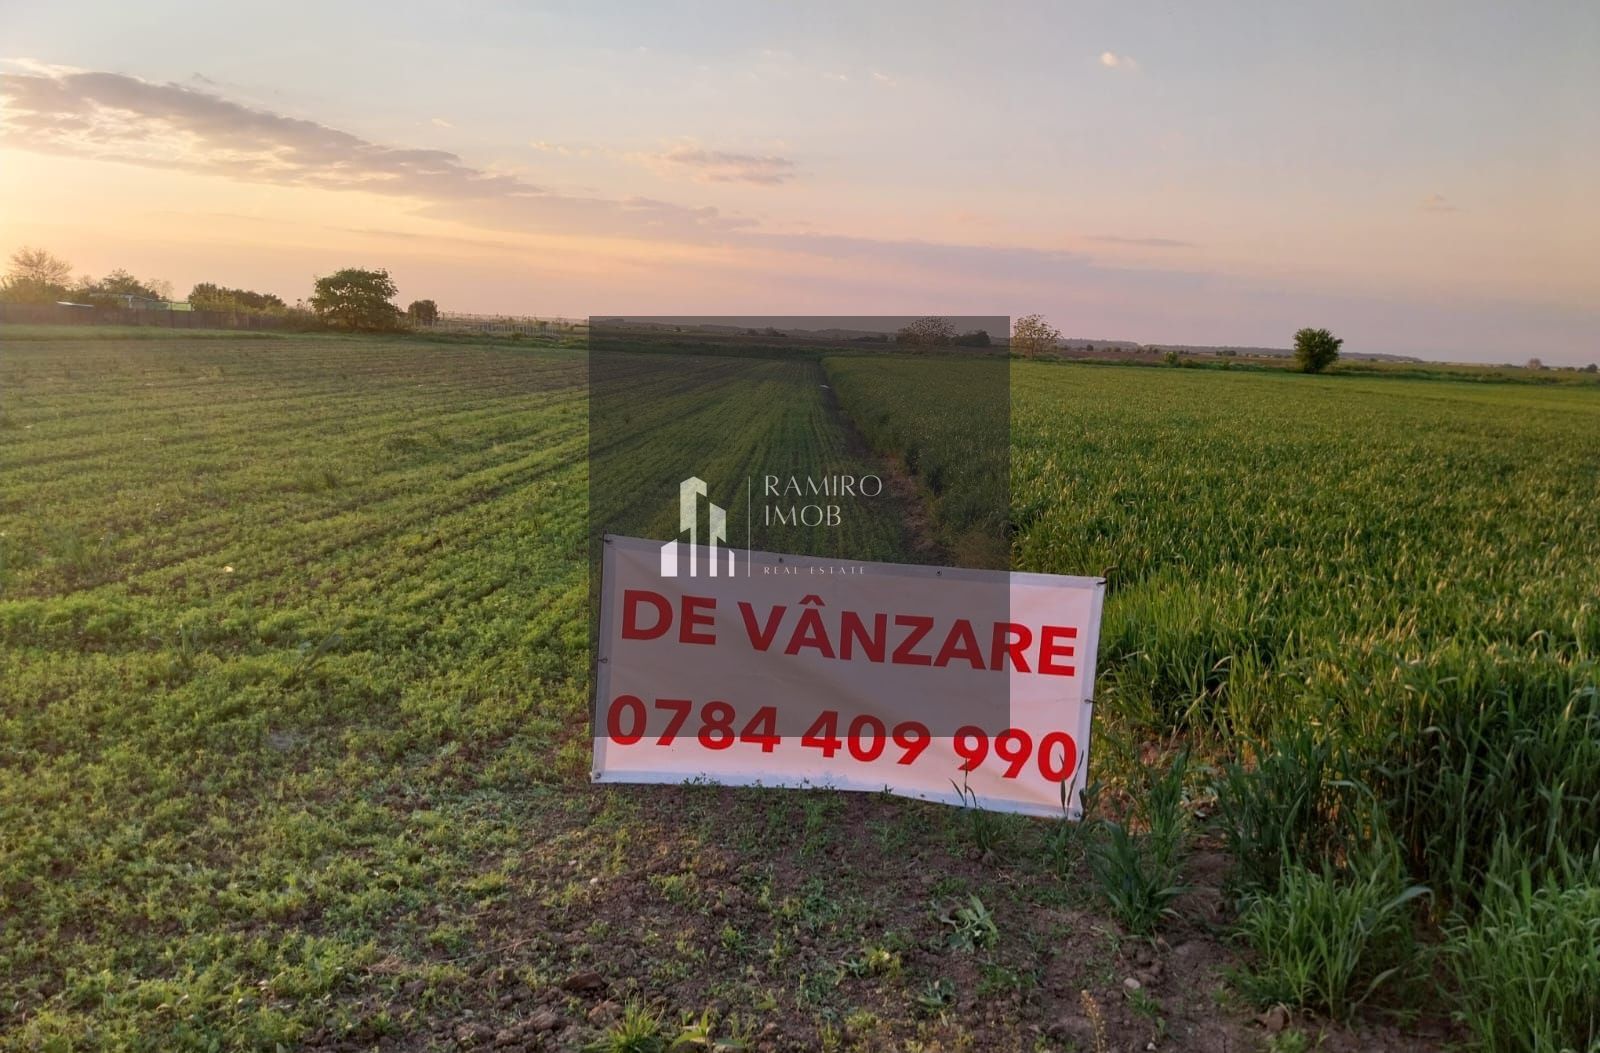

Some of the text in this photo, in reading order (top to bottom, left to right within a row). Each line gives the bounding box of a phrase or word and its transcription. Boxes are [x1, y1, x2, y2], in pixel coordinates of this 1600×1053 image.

[621, 588, 1078, 677] DE VÂNZARE
[606, 694, 1078, 783] 0784 409 990
